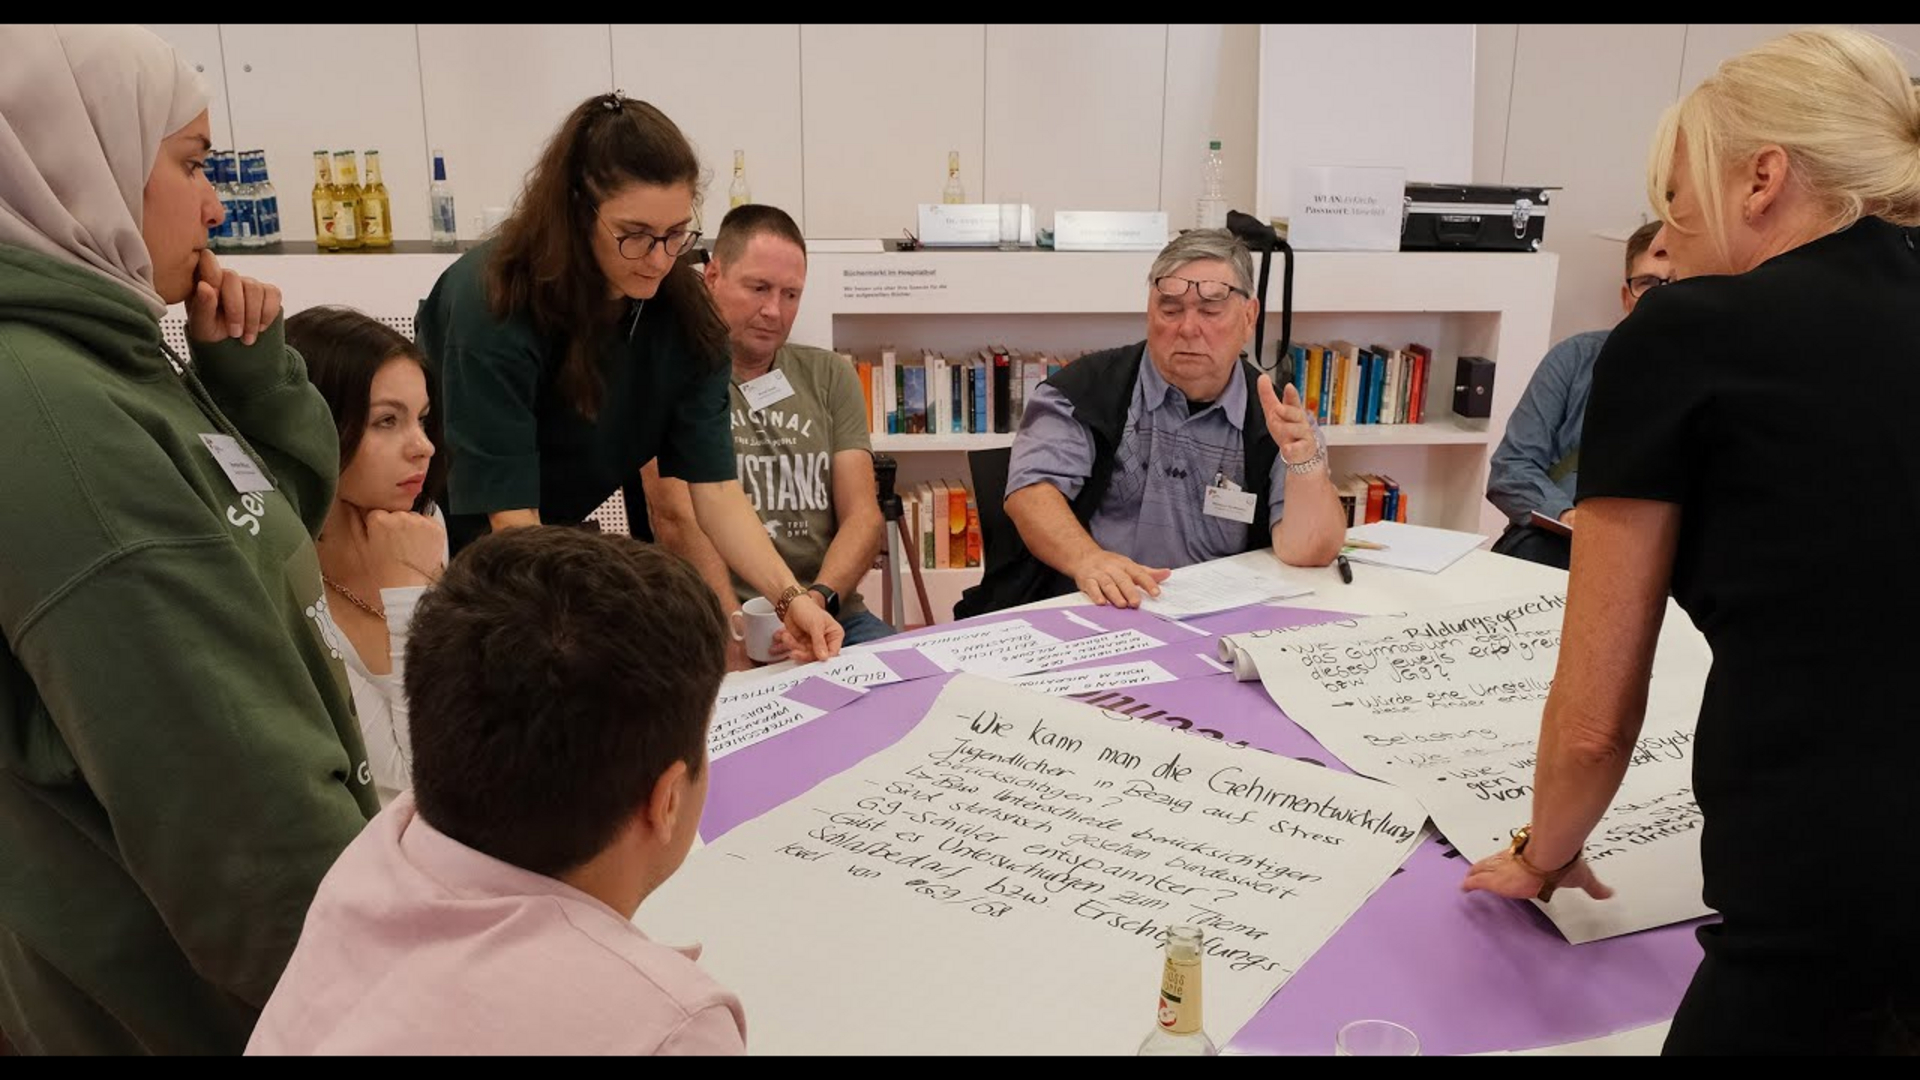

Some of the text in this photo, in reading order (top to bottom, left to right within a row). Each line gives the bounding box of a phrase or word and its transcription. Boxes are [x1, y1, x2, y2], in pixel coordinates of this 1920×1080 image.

[843, 269, 887, 277] Büchermarkt
[730, 408, 812, 438] RIGINAL
[737, 451, 829, 511] STANG
[1301, 652, 1337, 667] das
[1345, 638, 1463, 670] Gymnasium
[1311, 664, 1369, 681] dieses
[1386, 650, 1455, 683] jeweils
[1426, 690, 1467, 701] eine
[1468, 677, 1554, 697] Umstellu
[1363, 728, 1498, 747] Belastung
[1029, 718, 1083, 752] kann
[1097, 747, 1141, 769] man
[1152, 752, 1192, 782] die
[1208, 766, 1415, 843] Gehirnentwicklung
[1447, 765, 1505, 779] Wie
[929, 737, 1344, 846] Jugendlicher in Bezug auf Stress
[1491, 784, 1534, 802] von
[808, 825, 972, 880] Schlafbedarf
[1061, 833, 1151, 860] gesehen
[1165, 856, 1299, 900] bundesweit
[1131, 828, 1322, 883] berücksichtigen
[896, 831, 924, 843] es
[938, 837, 1104, 894] Untersuchungen
[1110, 890, 1169, 910] zum
[1186, 903, 1269, 940] Thema
